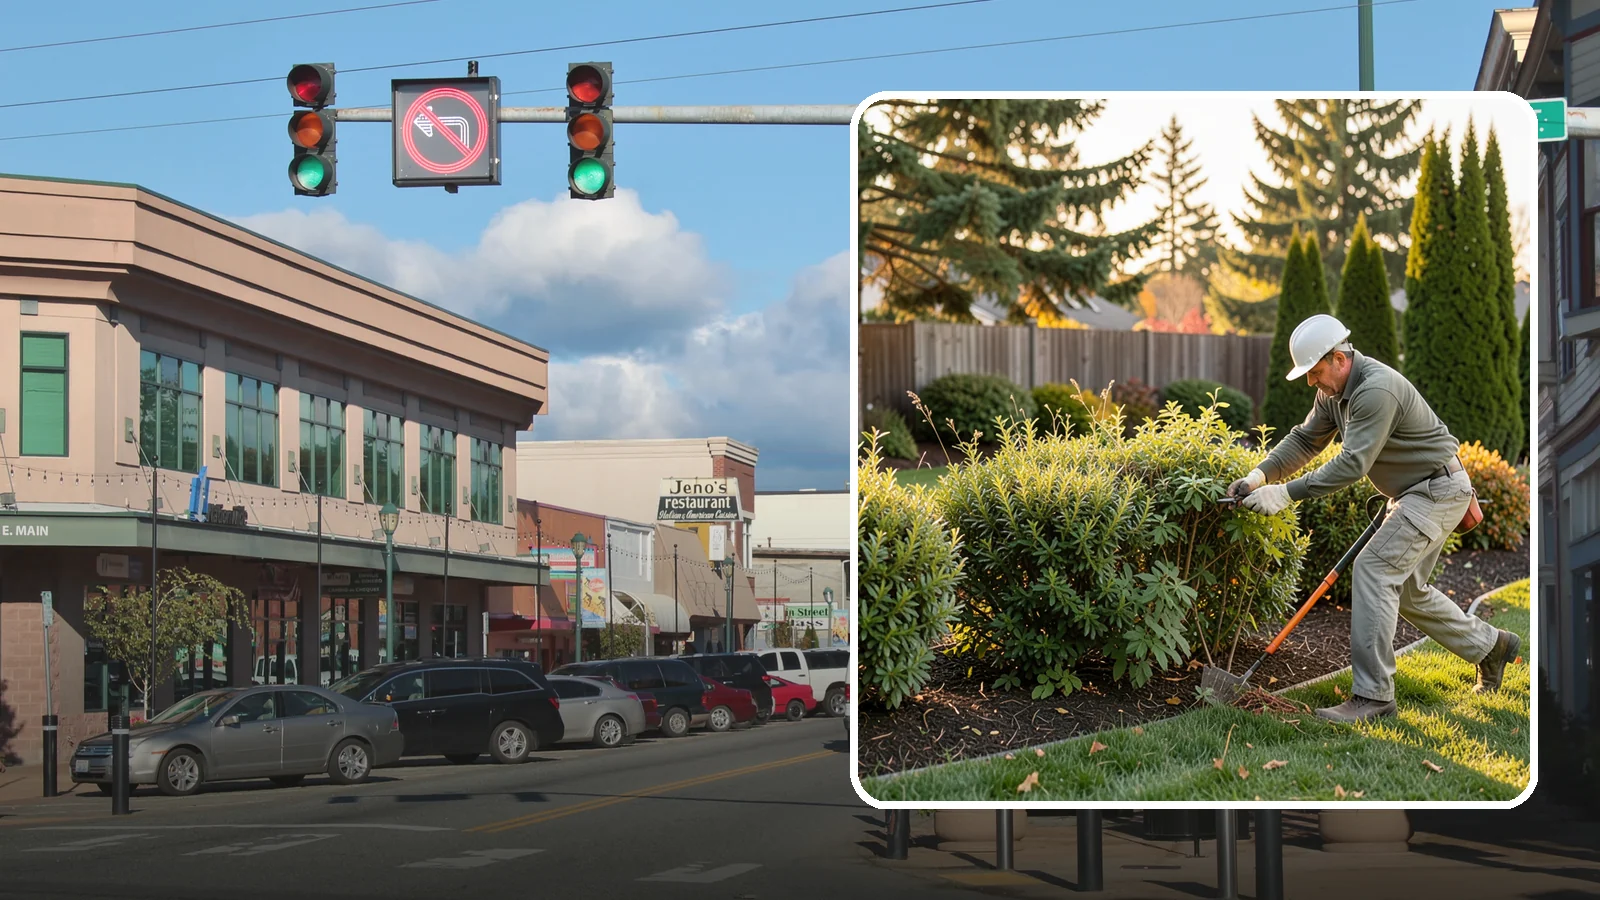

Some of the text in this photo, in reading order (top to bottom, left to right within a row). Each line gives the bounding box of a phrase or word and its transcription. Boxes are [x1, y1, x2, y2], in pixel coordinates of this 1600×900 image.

[670, 480, 727, 495] Jeno's
[665, 496, 731, 509] restaurant
[658, 510, 681, 520] Italian
[686, 510, 714, 519] American
[715, 509, 738, 519] Cuisine
[2, 525, 49, 536] E. MAIN
[797, 607, 828, 617] Street
[790, 619, 824, 627] lass
